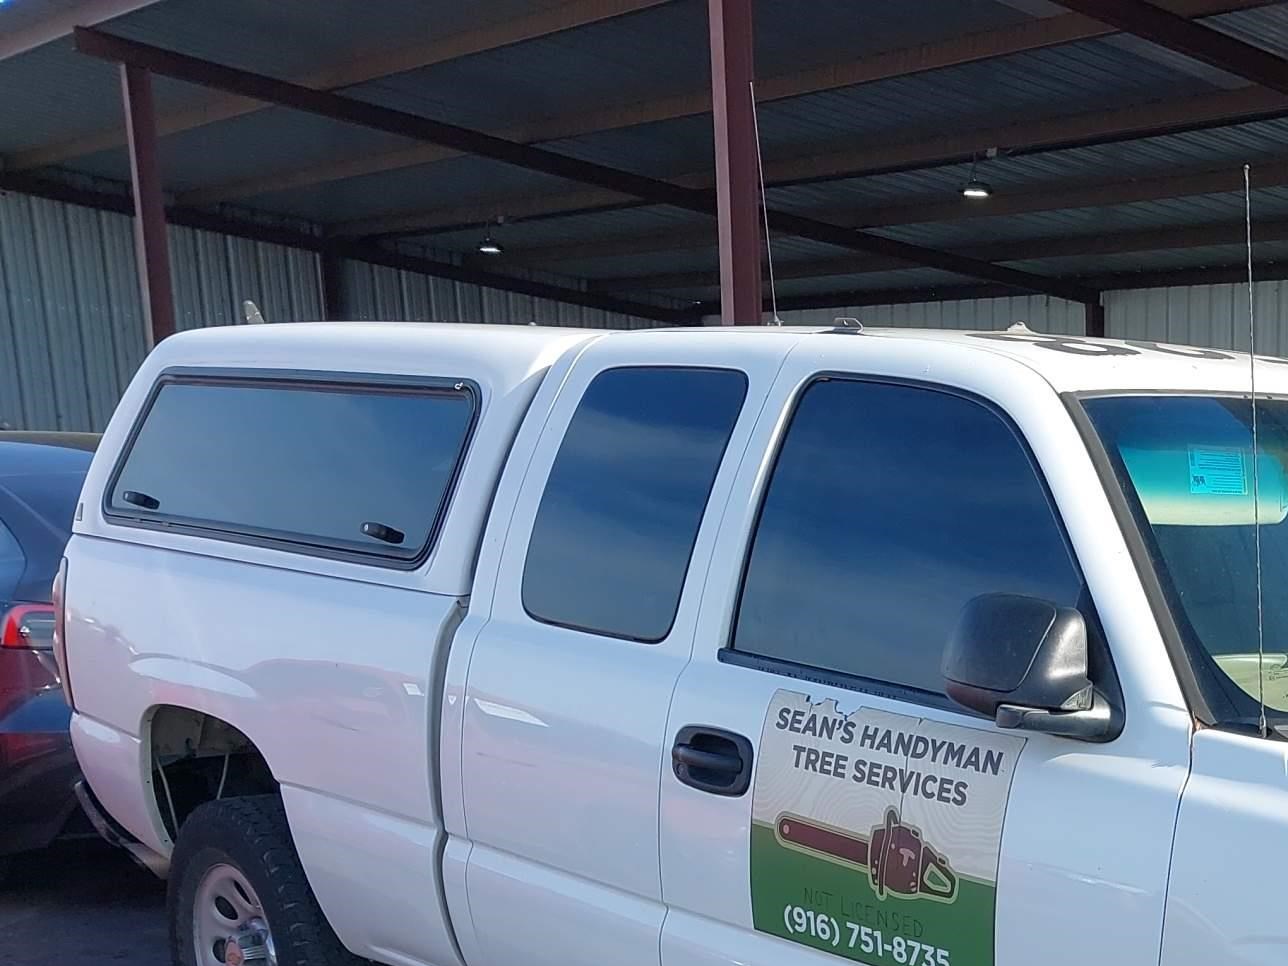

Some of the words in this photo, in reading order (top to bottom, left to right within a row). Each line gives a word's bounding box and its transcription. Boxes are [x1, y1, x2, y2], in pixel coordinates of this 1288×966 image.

[775, 707, 857, 744] SEAN'S
[859, 724, 1004, 776] HANDYMAN
[792, 744, 849, 779] TREE
[851, 758, 969, 807] SERVICES
[783, 904, 840, 947] (916)
[803, 887, 833, 910] NOT
[840, 896, 924, 937] LICENSED
